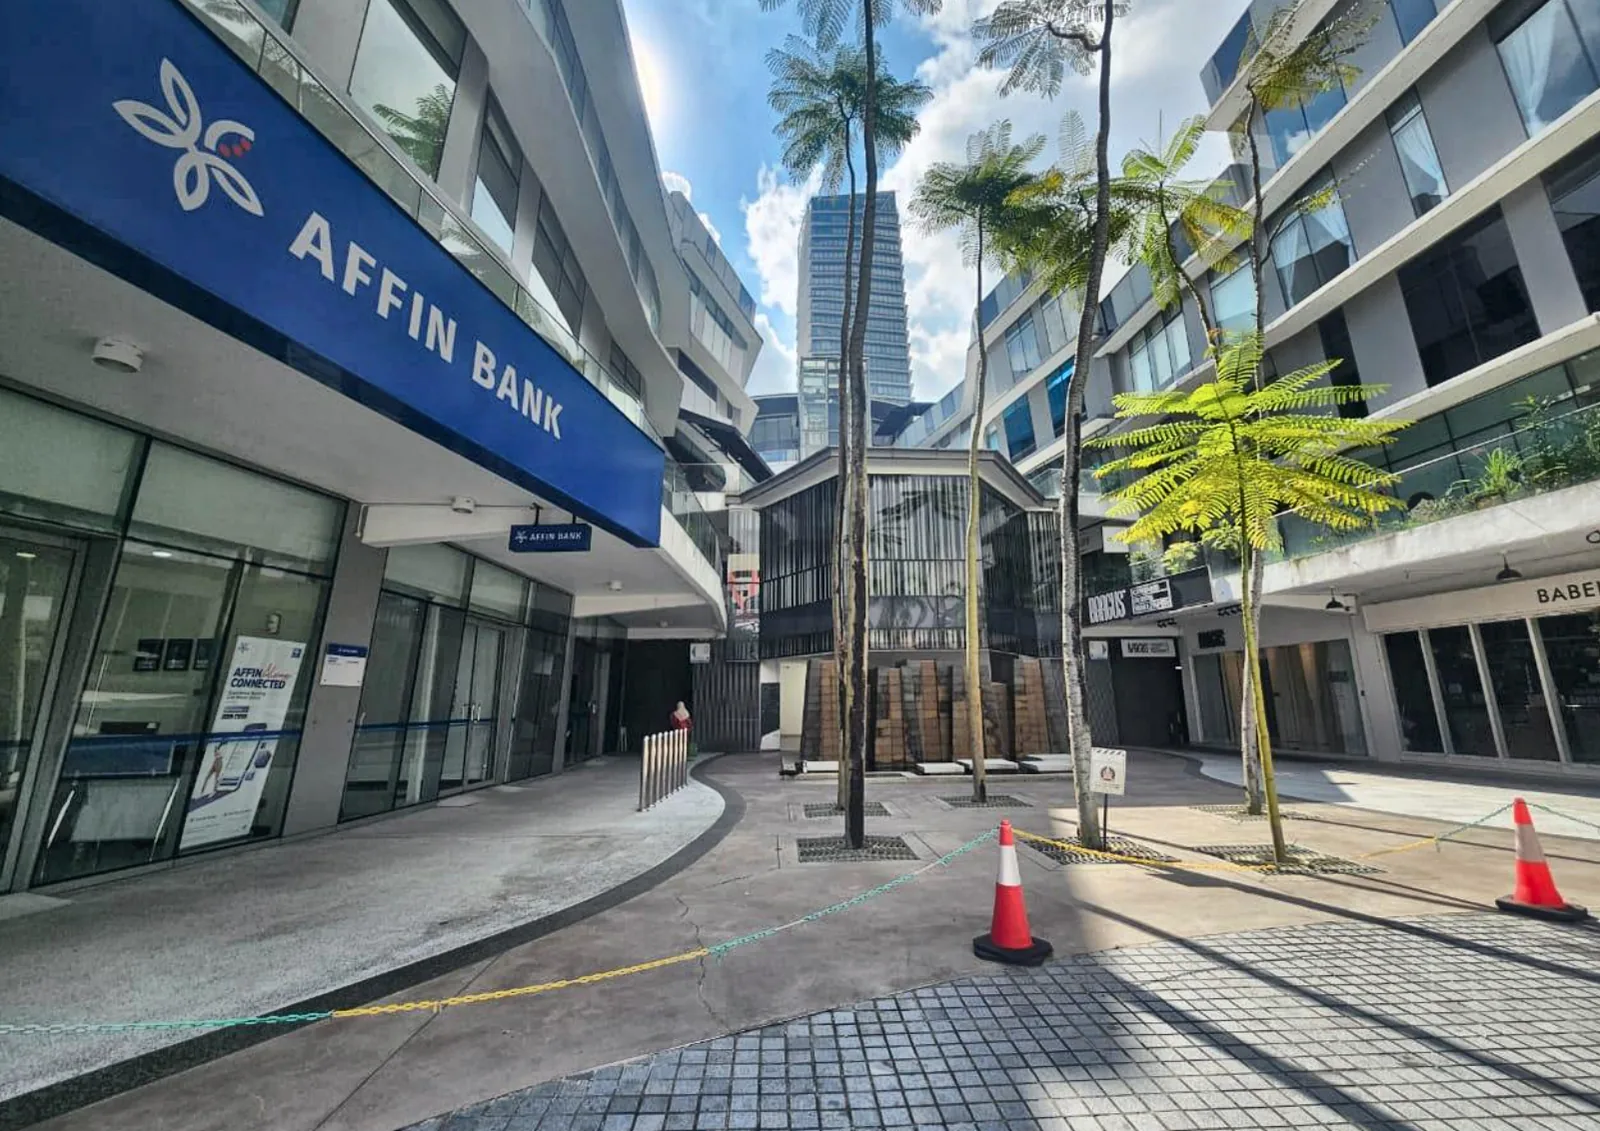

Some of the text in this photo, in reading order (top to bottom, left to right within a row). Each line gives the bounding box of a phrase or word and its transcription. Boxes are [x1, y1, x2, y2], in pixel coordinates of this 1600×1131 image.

[288, 211, 563, 440] AFFIN BANK
[529, 532, 582, 541] AFFIN BANK
[233, 667, 263, 678] AFFIN
[230, 678, 286, 690] CONNECTED
